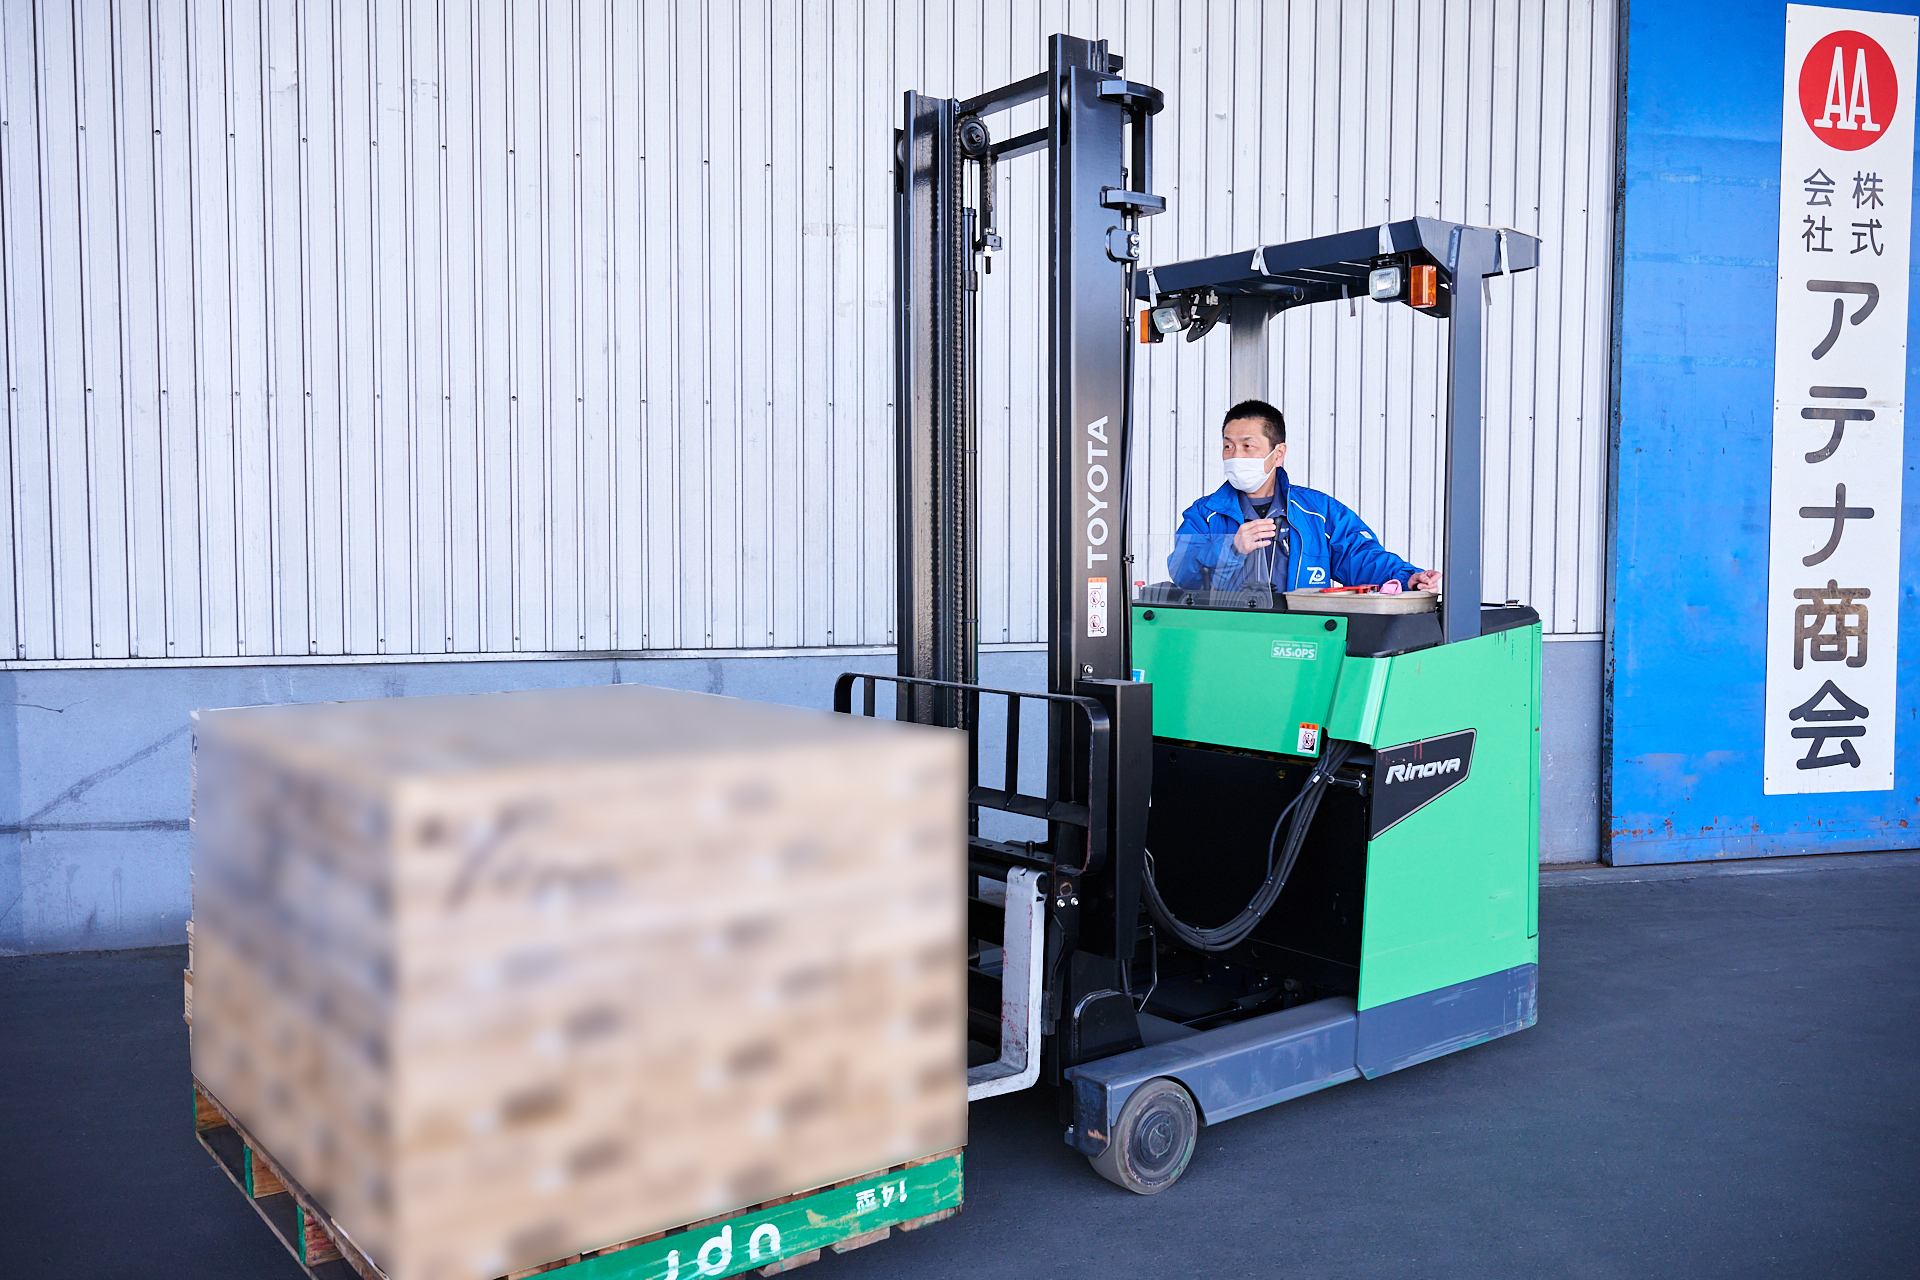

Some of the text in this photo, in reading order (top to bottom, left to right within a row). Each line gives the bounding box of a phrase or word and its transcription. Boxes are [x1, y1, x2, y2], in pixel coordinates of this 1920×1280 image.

[1802, 168, 1836, 253] 会社
[1850, 171, 1884, 256] 株式
[1087, 415, 1109, 569] TOYOTA
[1789, 279, 1880, 770] アテナ商会
